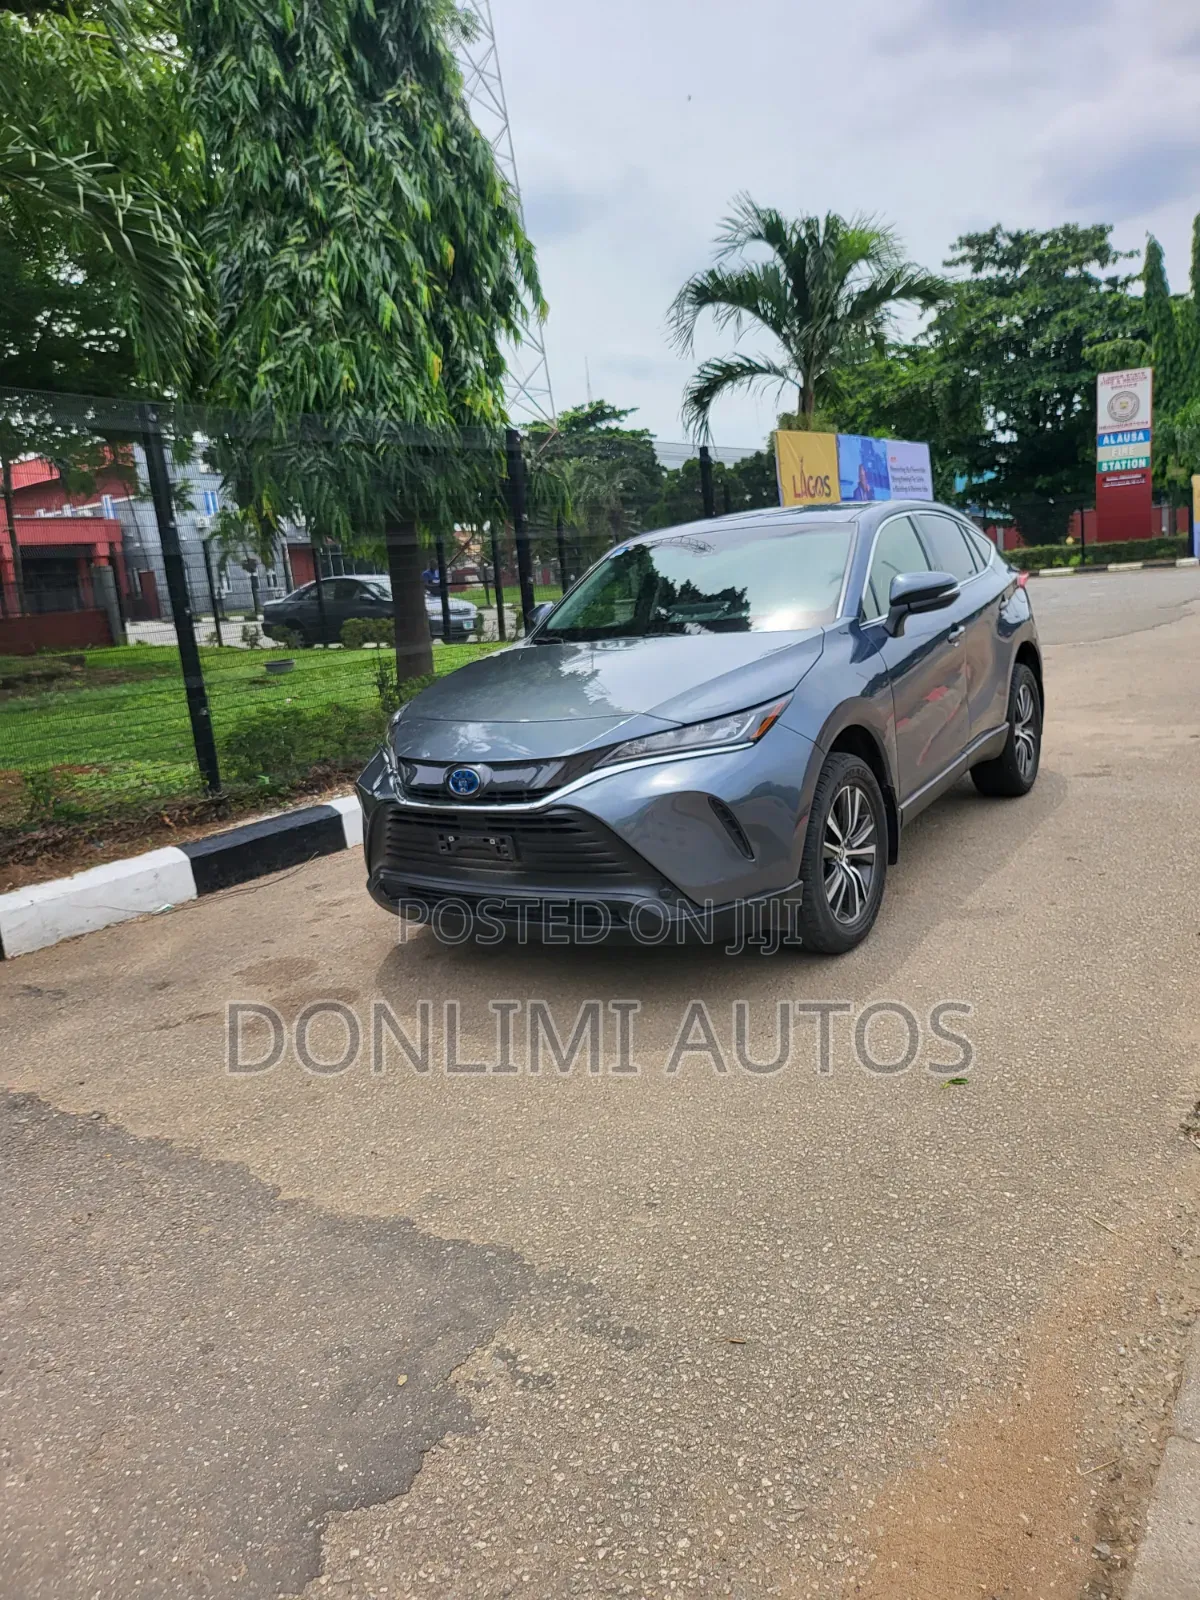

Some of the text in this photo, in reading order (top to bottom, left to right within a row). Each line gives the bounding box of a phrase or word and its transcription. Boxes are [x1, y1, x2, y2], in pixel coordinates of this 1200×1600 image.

[1102, 431, 1145, 445] ALAUSA
[1101, 458, 1147, 472] STATION
[792, 457, 832, 499] LAGOS
